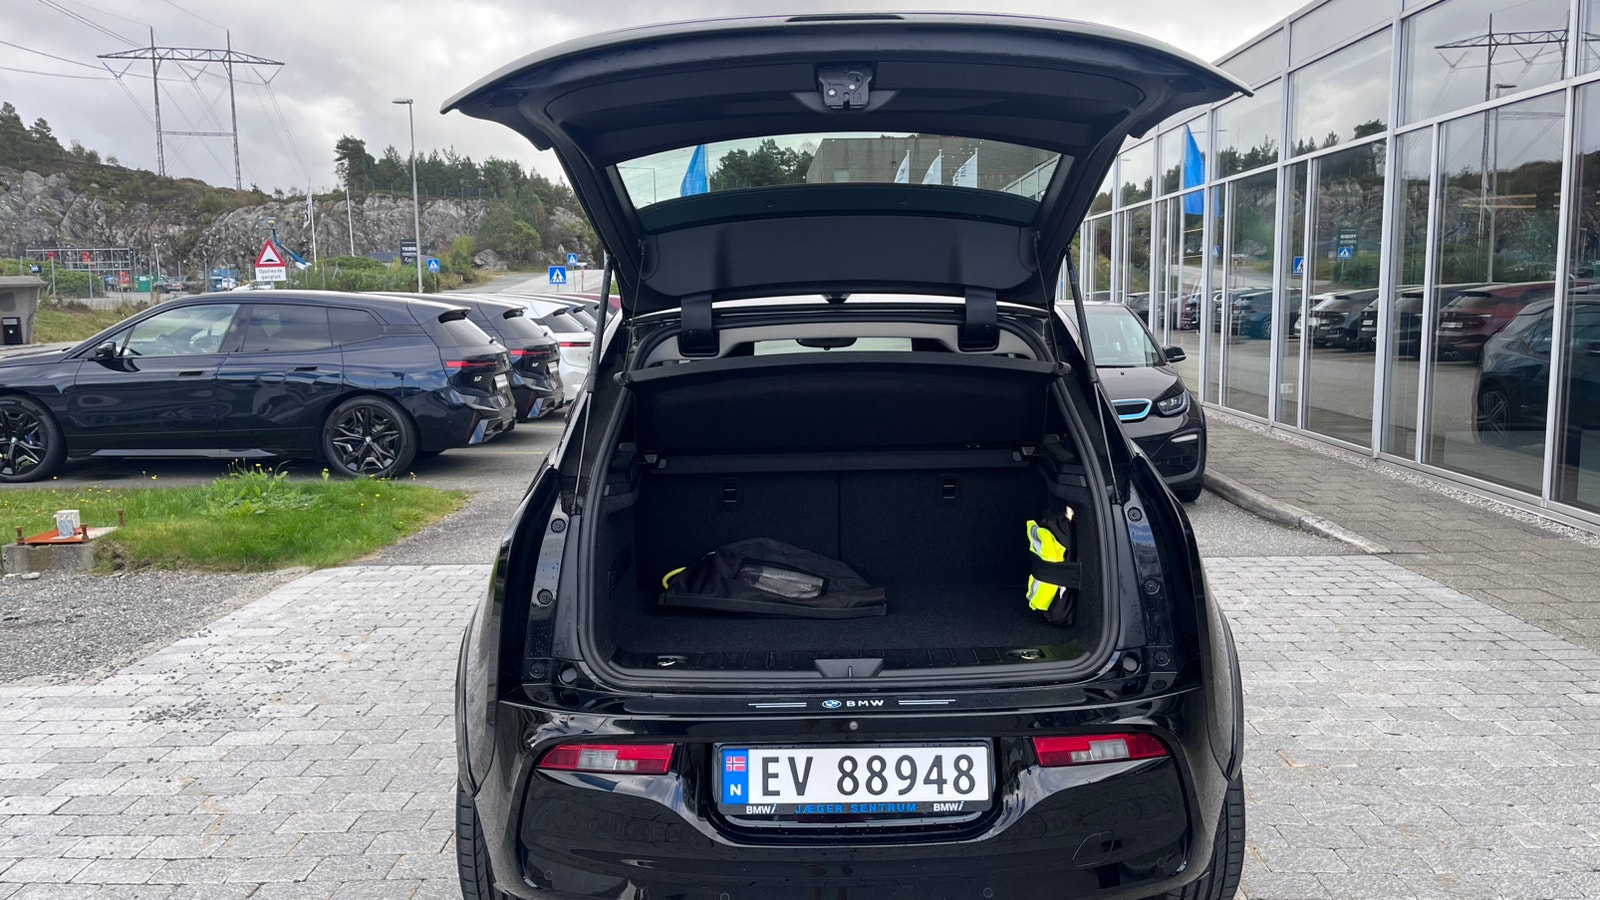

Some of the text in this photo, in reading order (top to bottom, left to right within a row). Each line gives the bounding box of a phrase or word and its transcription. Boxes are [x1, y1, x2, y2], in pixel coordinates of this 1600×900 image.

[846, 699, 885, 708] BMW
[761, 754, 976, 797] EV 88948
[729, 784, 742, 796] N
[795, 802, 918, 814] JÆGER SENTRUM
